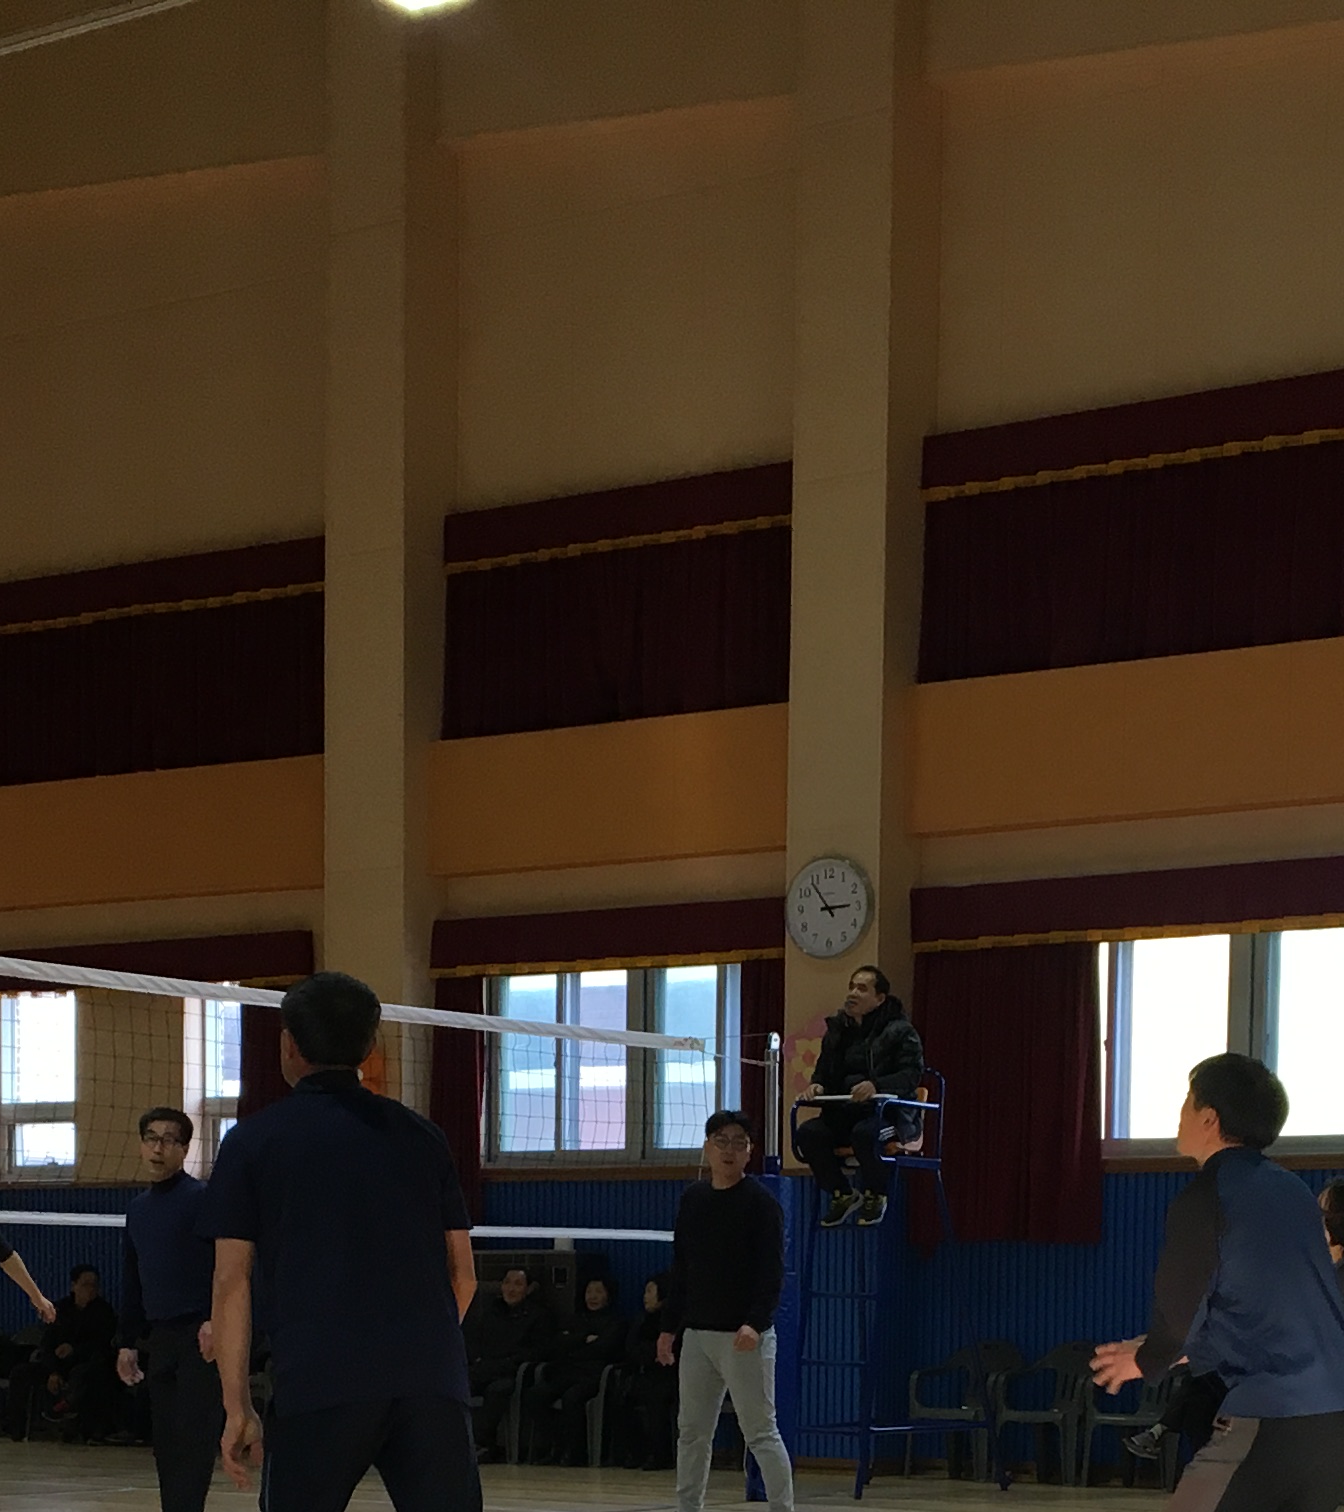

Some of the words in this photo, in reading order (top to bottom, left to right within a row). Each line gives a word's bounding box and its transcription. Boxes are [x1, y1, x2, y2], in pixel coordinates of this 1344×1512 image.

[824, 867, 835, 879] 12
[799, 887, 811, 899] 10
[851, 882, 858, 894] 2
[797, 904, 804, 915] 9
[855, 900, 862, 911] 3
[801, 921, 808, 933] 8
[850, 918, 857, 929] 4
[812, 933, 818, 944] 7
[840, 931, 847, 942] 5
[825, 937, 833, 948] 6
